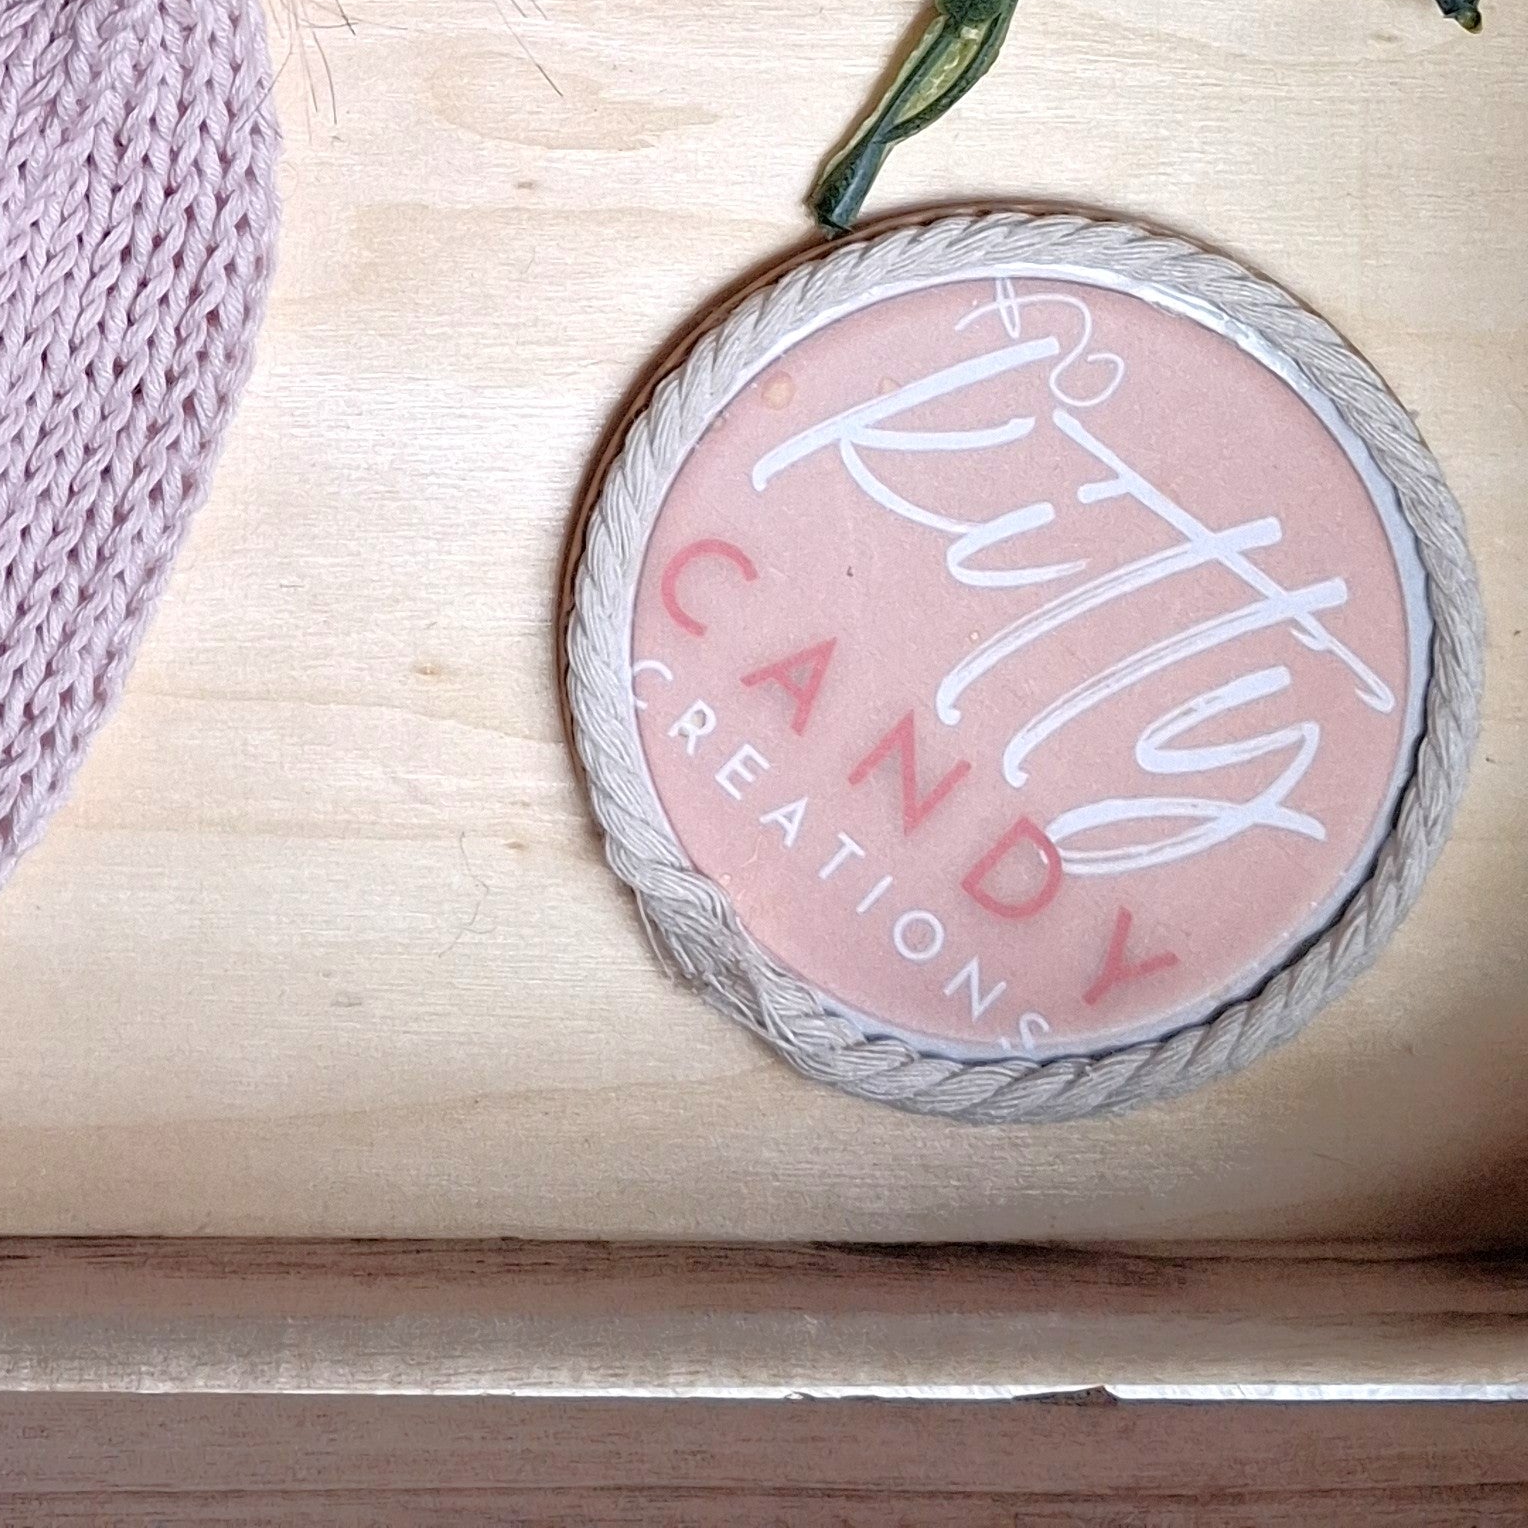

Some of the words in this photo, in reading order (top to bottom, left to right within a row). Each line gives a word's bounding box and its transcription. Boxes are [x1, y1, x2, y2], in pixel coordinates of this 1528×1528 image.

[659, 537, 1180, 1006] CANDY
[751, 336, 1395, 874] Kitty
[632, 659, 1052, 1052] CREATIONS
